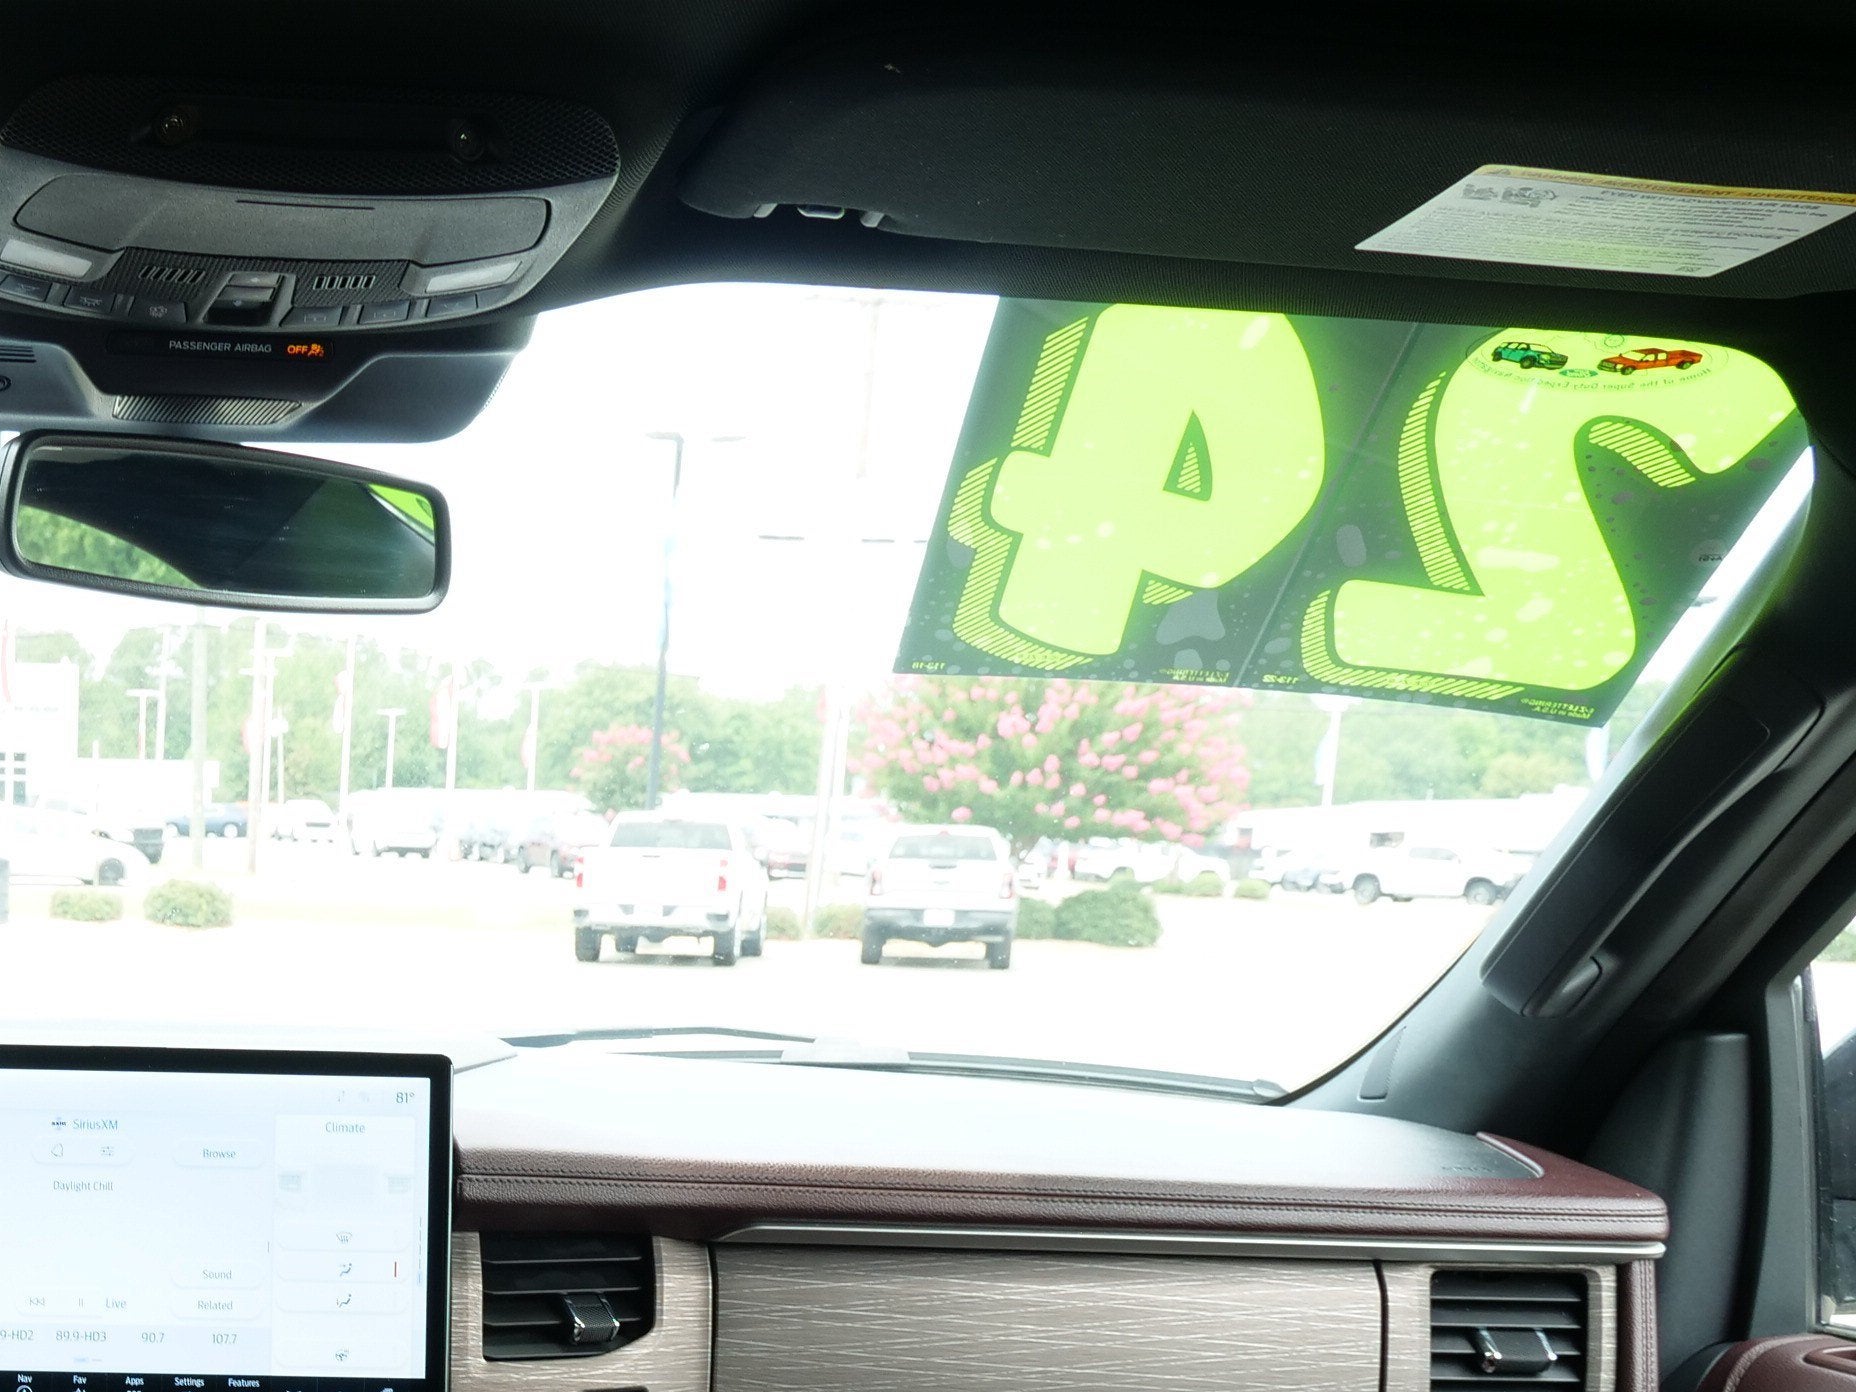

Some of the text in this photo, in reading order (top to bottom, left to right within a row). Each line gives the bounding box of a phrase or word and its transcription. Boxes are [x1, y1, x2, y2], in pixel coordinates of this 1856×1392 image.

[168, 340, 308, 355] PASSENGER AIRBAG OFF
[72, 1119, 118, 1131] SiriusXM
[325, 1121, 366, 1134] Climate
[202, 1148, 236, 1159] Browse
[53, 1180, 114, 1193] Daylight Chill
[202, 1269, 233, 1280] Sound
[105, 1298, 127, 1310] Live
[197, 1299, 234, 1311] Related
[55, 1329, 107, 1342] 89.9-HD3
[141, 1332, 165, 1344] 90.7
[211, 1333, 238, 1346] 107.7
[17, 1374, 32, 1384] Nav
[73, 1375, 87, 1385] Fav
[125, 1376, 144, 1387] Apps
[174, 1377, 205, 1389] Settings
[227, 1378, 260, 1388] Features
